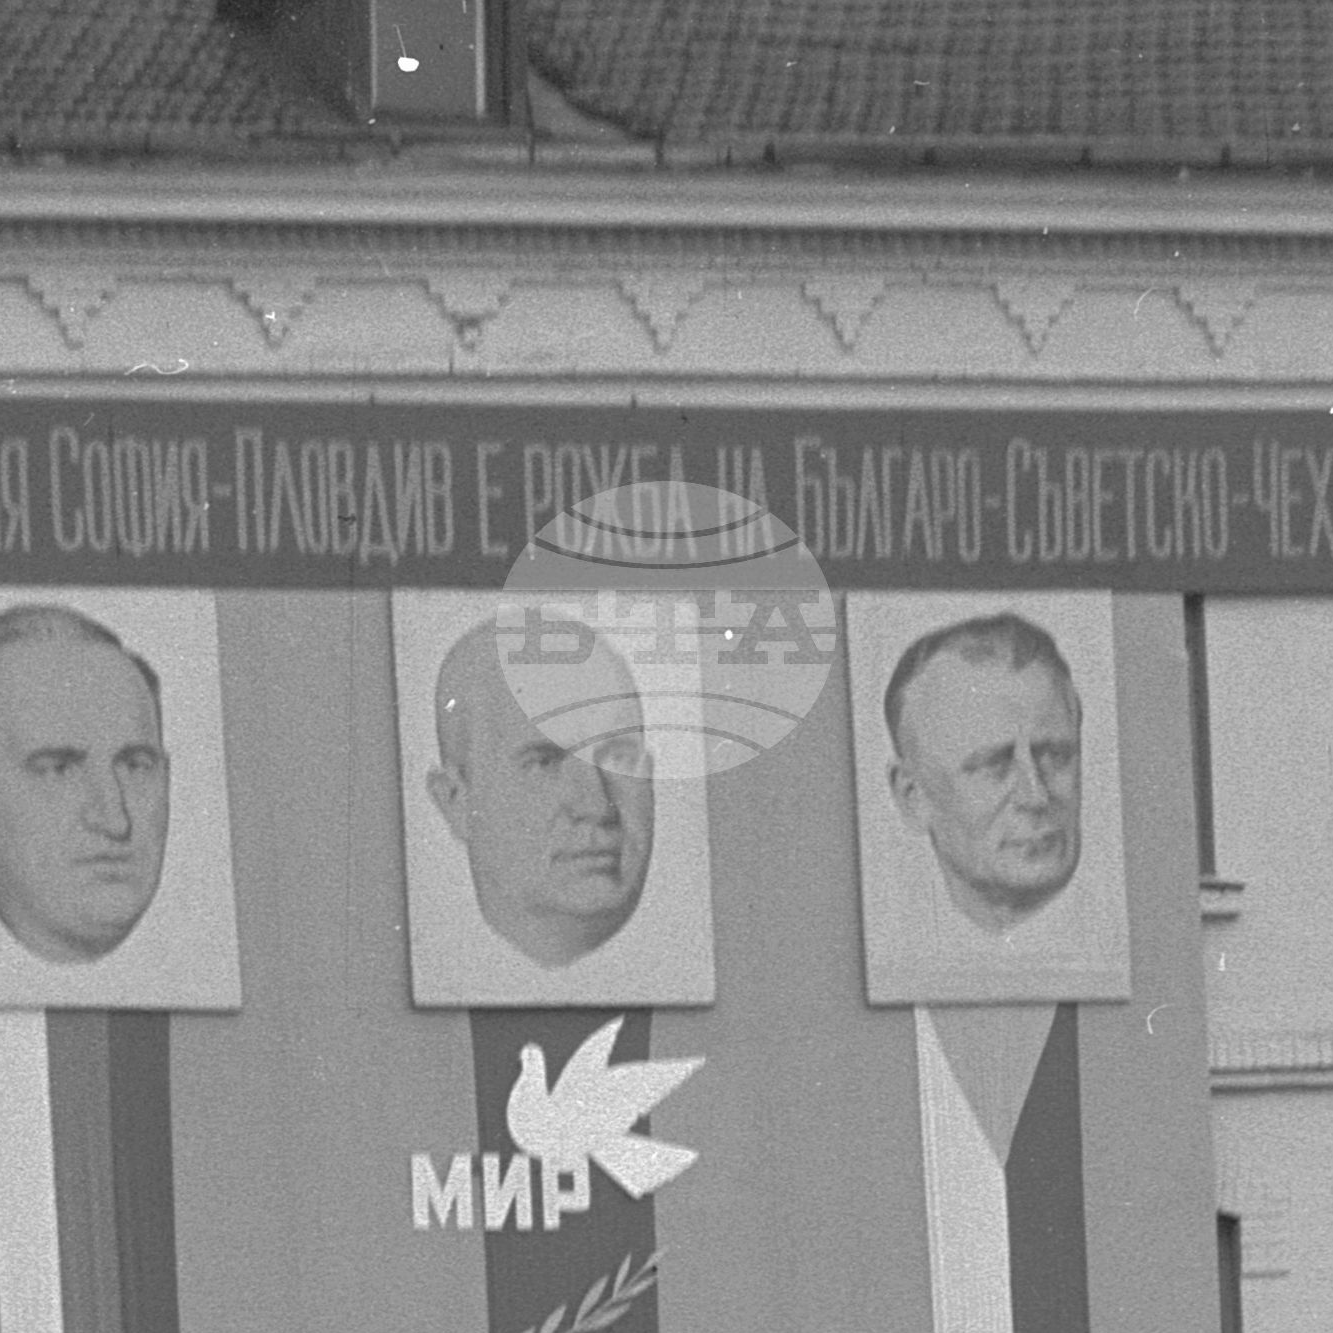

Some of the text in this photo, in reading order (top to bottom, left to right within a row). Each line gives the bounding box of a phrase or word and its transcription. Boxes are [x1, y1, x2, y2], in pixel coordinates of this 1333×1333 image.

[475, 440, 509, 557] Е
[522, 442, 698, 560] РОЖБА
[716, 443, 777, 560] НА
[411, 1152, 591, 1231] МИР
